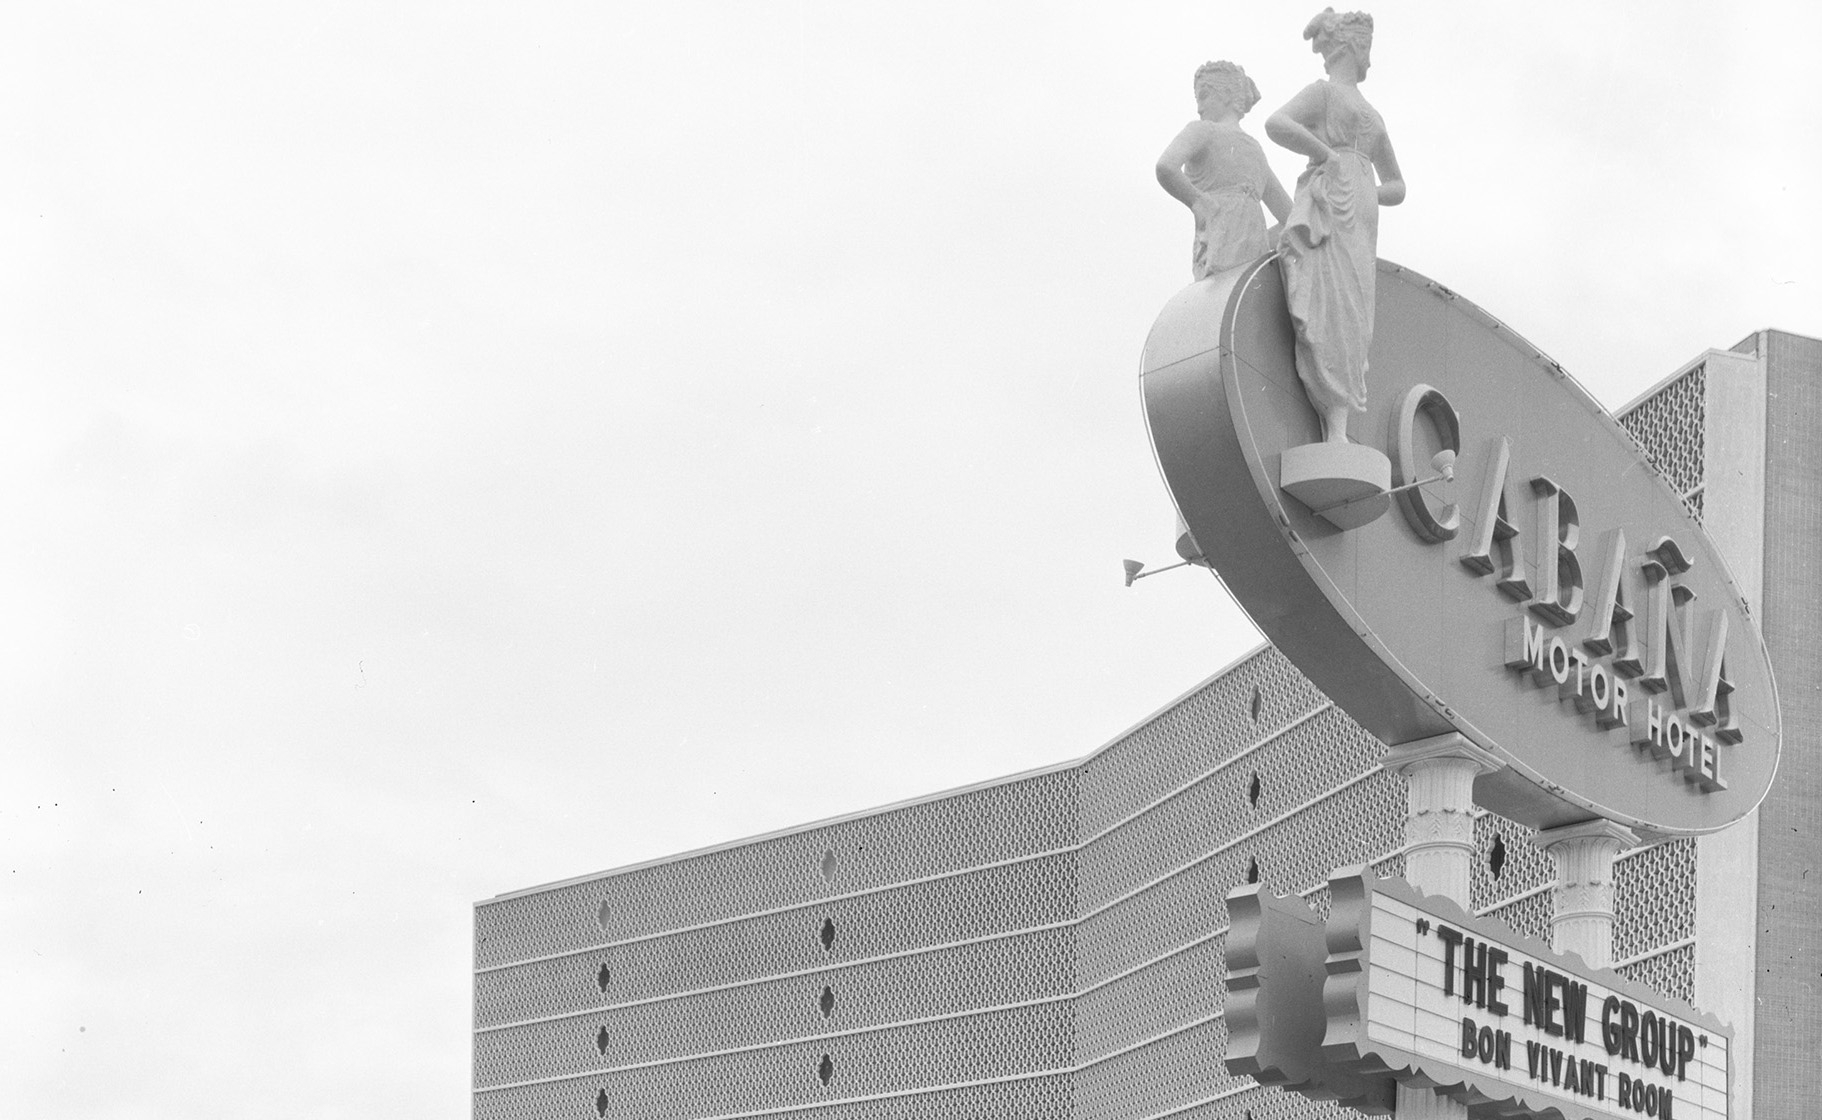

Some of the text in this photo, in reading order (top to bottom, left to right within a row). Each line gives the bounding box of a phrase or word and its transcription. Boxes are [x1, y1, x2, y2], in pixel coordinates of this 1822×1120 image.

[1522, 615, 1728, 790] MOTOR HOTEL
[1523, 960, 1588, 1044] NEW
[1462, 1016, 1512, 1070] BON
[1526, 1039, 1608, 1101] VIVANT
